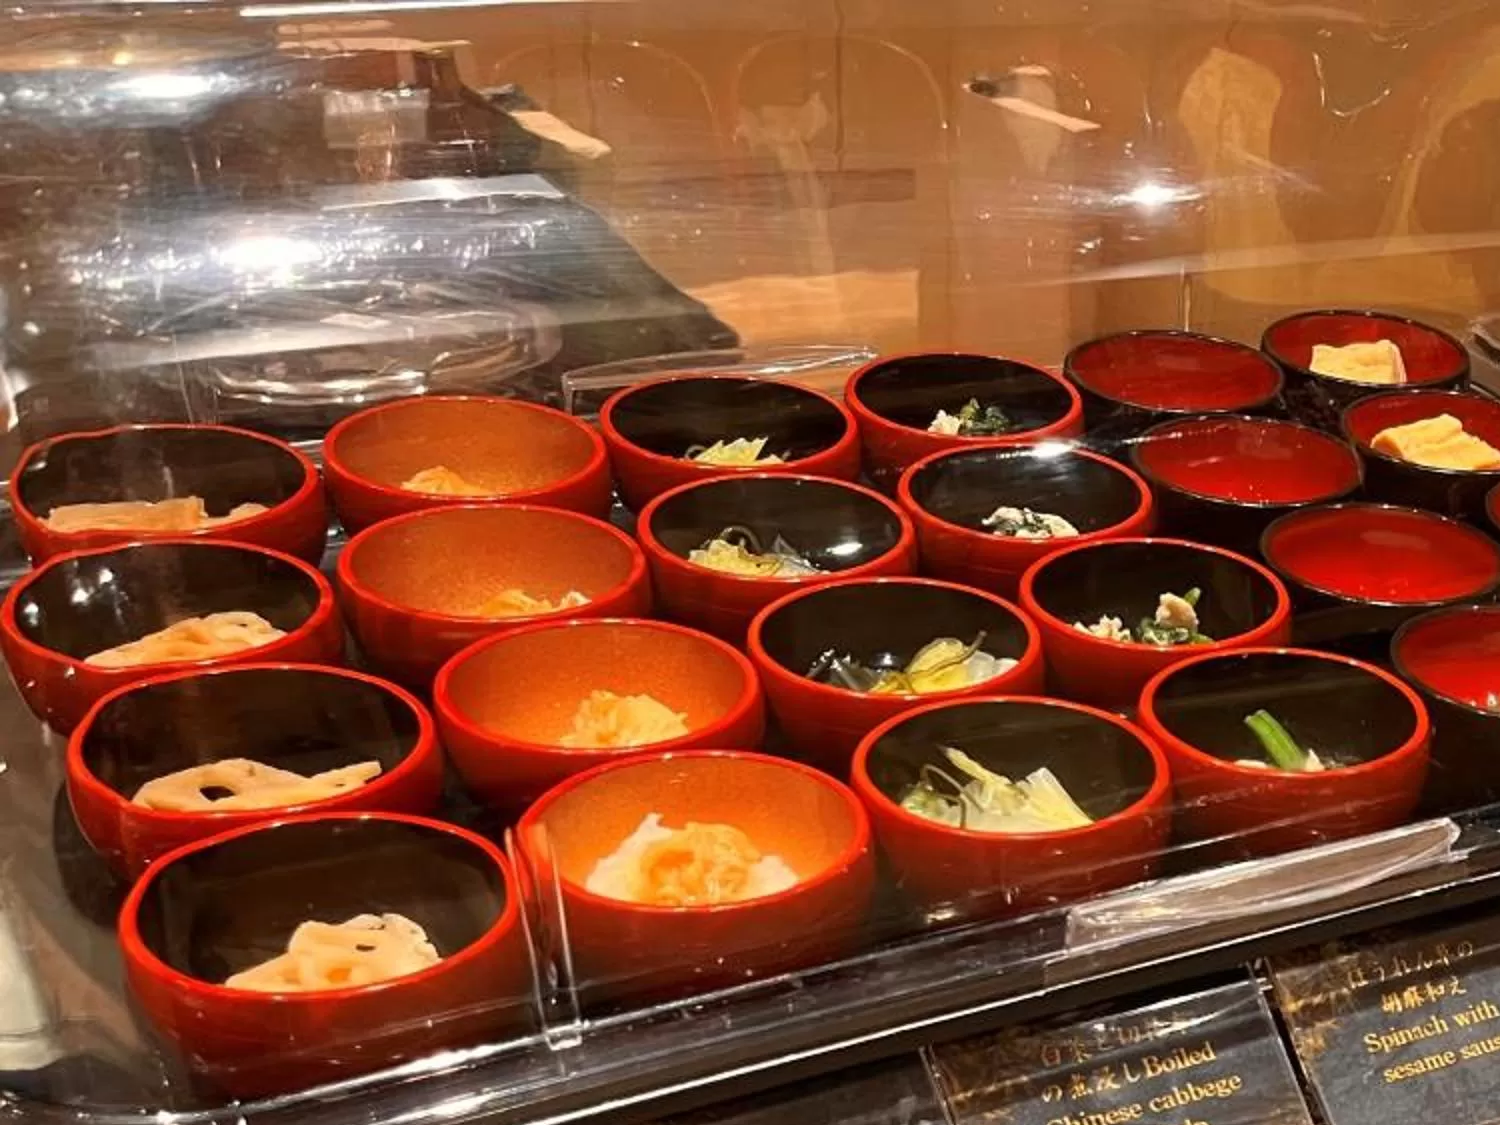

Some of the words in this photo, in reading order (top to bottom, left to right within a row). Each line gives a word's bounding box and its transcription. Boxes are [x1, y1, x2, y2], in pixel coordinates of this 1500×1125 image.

[1363, 1014, 1450, 1054] Spinach
[1452, 999, 1500, 1028] with
[1140, 1041, 1217, 1079] Boiled
[1382, 1049, 1457, 1084] sesame
[1148, 1074, 1243, 1113] cabbege
